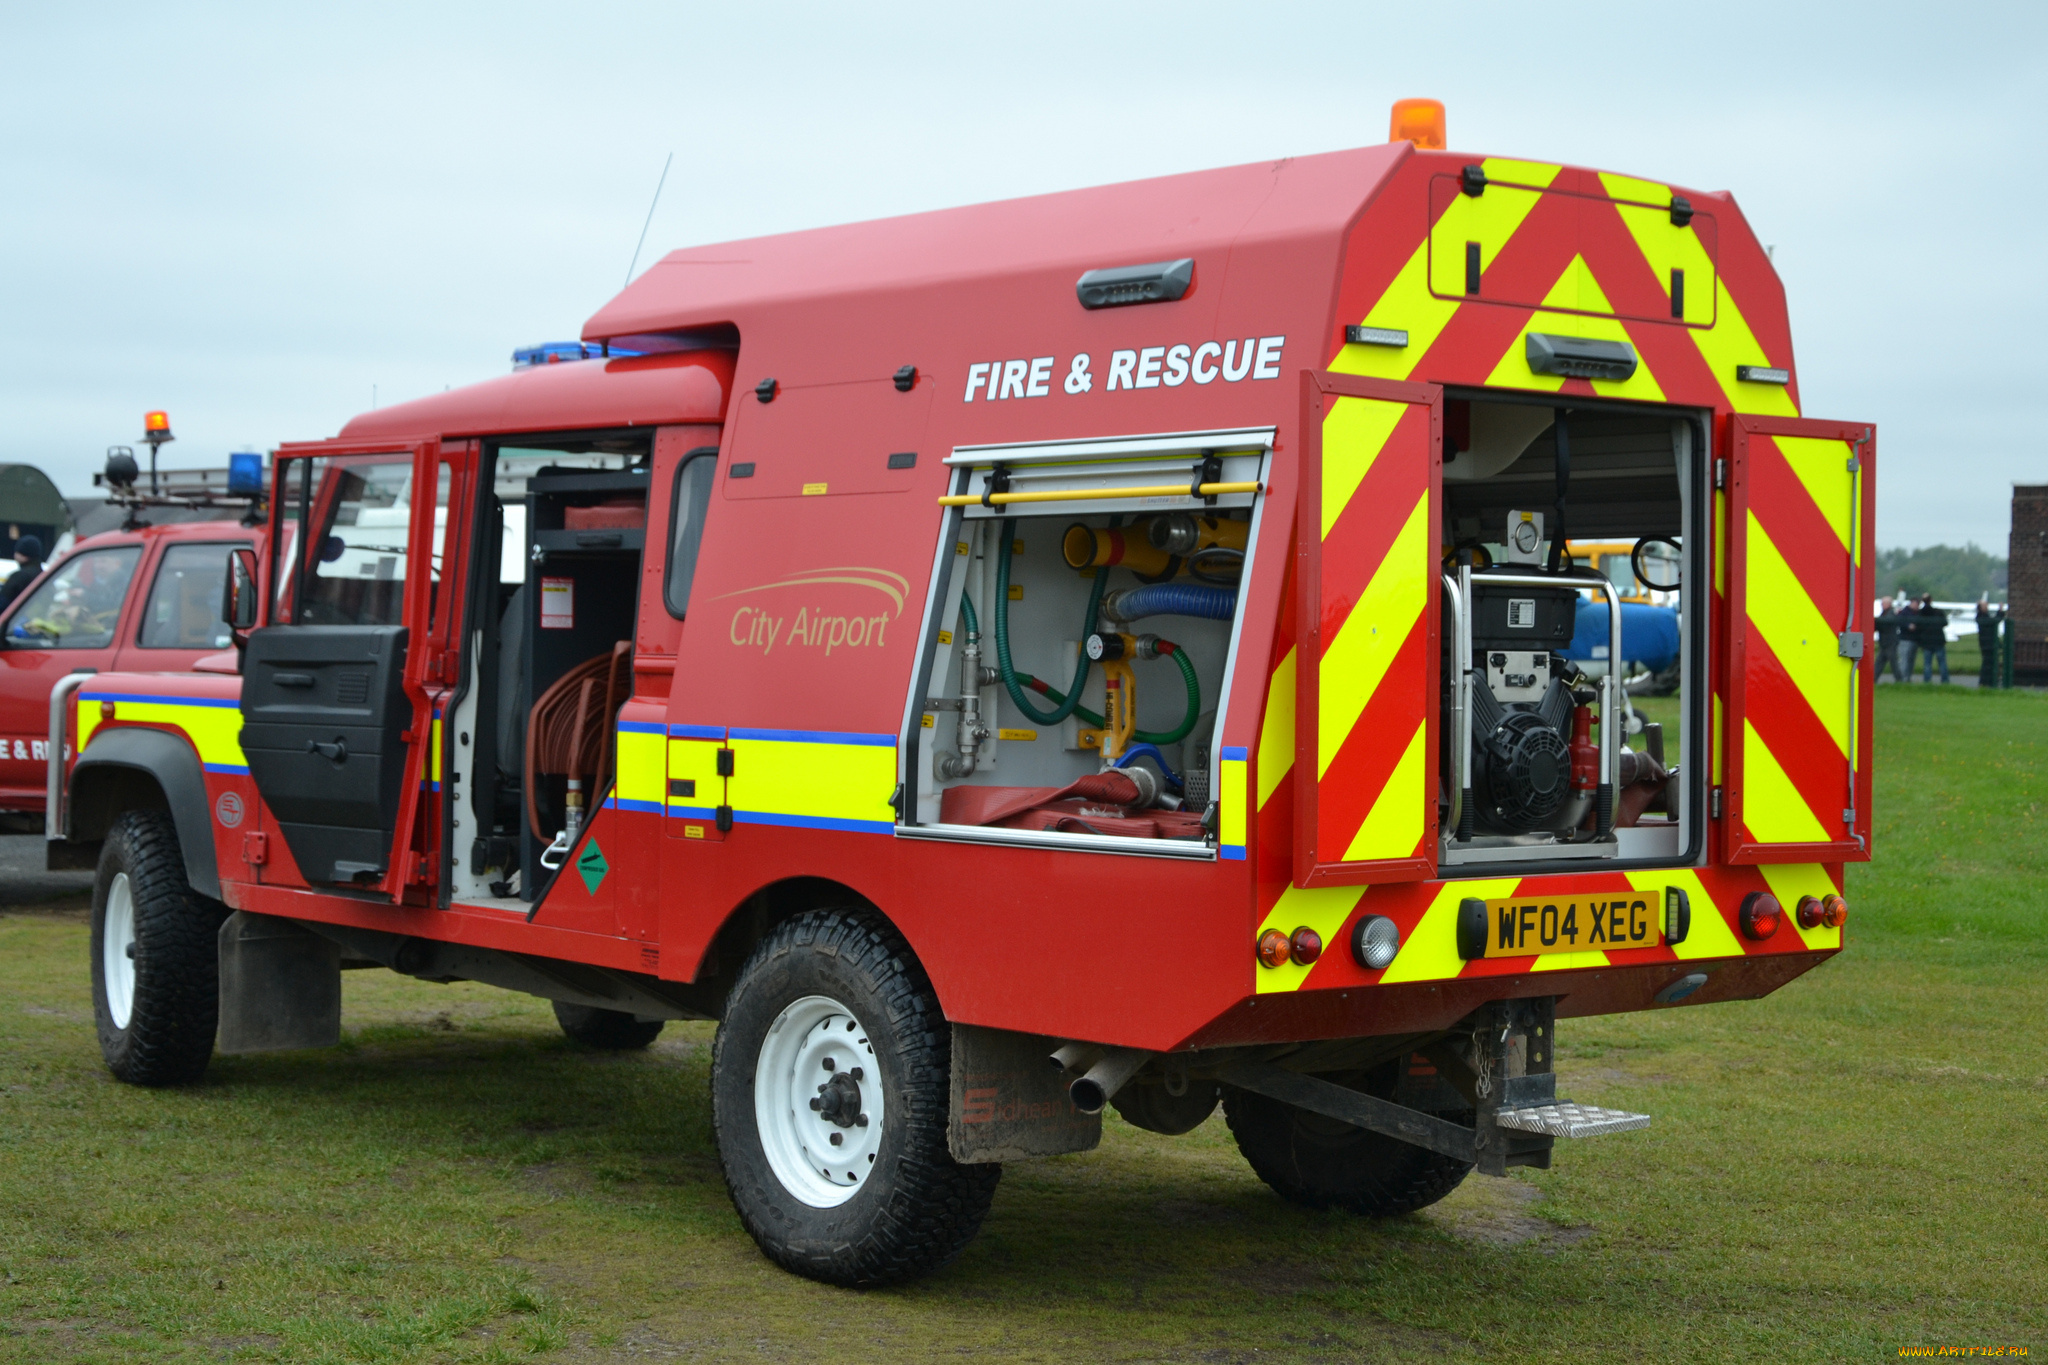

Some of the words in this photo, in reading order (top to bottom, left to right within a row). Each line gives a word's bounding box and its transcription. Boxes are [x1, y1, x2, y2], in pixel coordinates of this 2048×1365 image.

[963, 356, 1055, 402] FIRE
[1063, 352, 1093, 395] &
[1106, 335, 1286, 391] RESCUE
[730, 606, 783, 656] City
[786, 606, 889, 657] Airport
[13, 739, 29, 760] &
[1498, 903, 1578, 949] WF04
[1589, 900, 1647, 944] XEG
